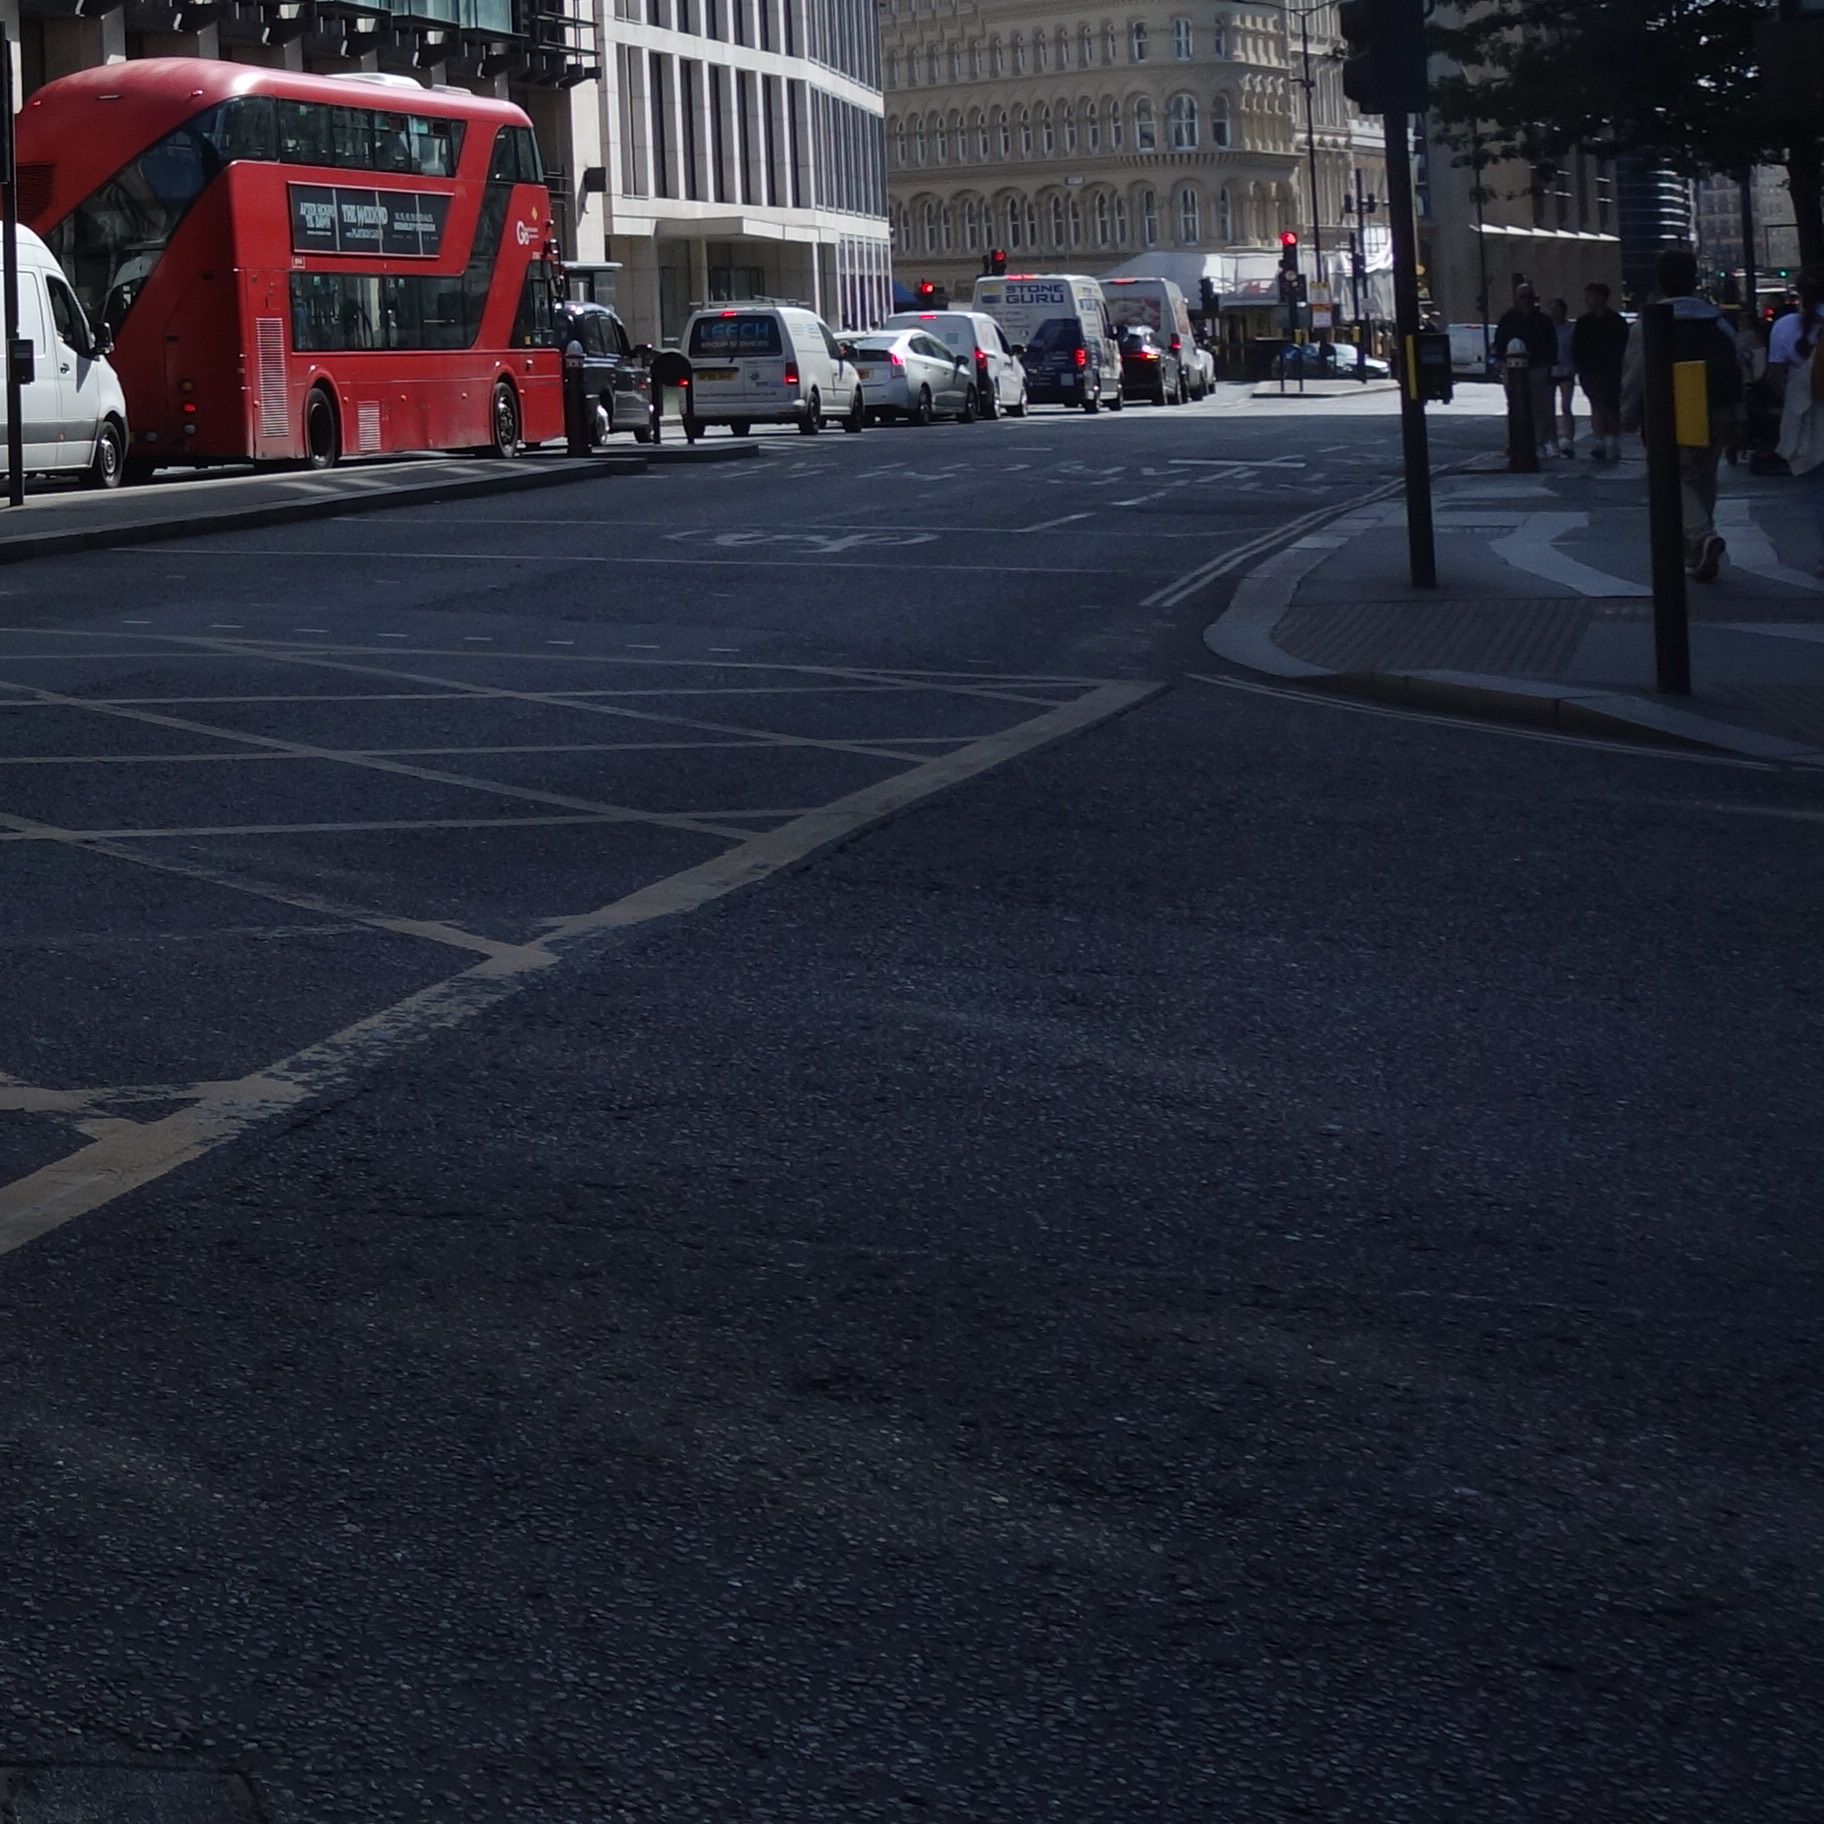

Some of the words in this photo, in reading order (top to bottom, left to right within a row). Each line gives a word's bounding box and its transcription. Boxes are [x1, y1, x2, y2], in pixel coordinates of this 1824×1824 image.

[1005, 284, 1064, 293] STONE
[1005, 294, 1064, 304] GURU
[700, 322, 769, 338] LEECH
